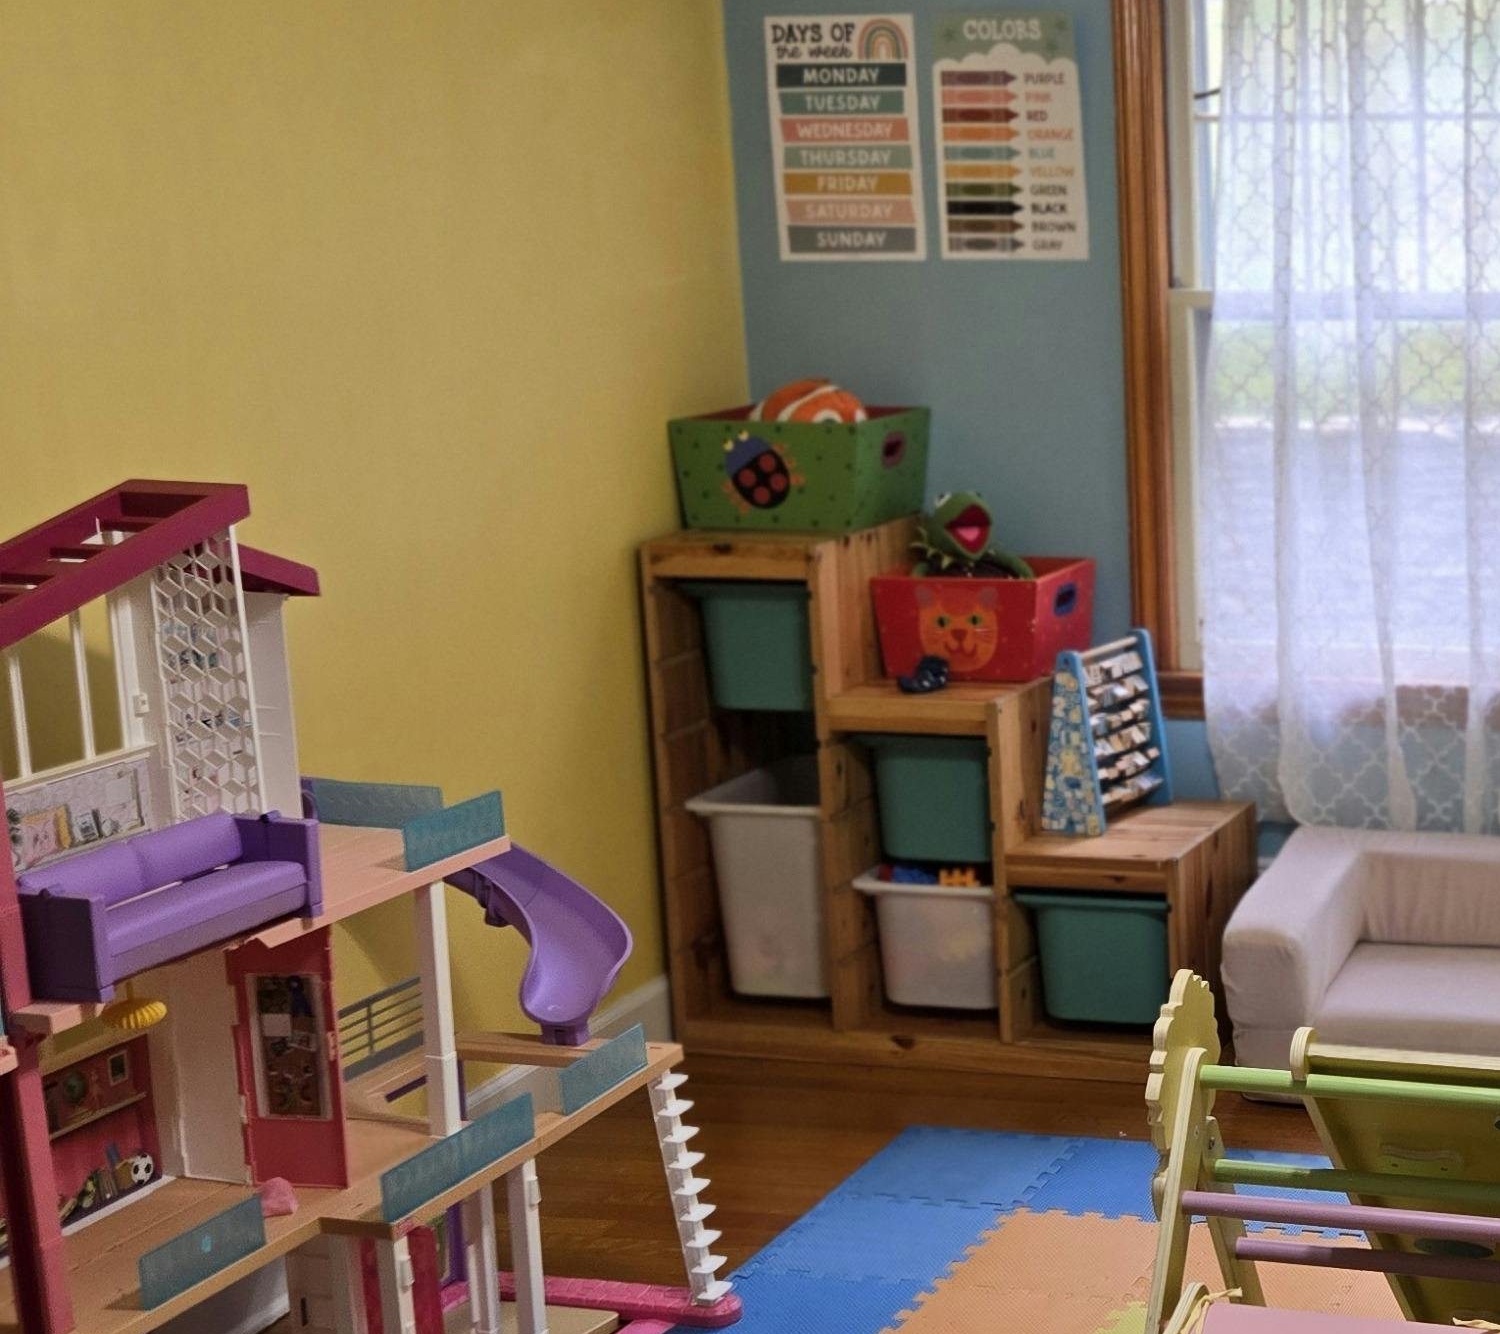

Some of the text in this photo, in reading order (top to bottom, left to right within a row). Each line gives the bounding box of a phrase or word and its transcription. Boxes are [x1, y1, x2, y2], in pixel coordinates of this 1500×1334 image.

[771, 22, 855, 44] DAYS OF
[963, 19, 1043, 41] COLORS
[775, 44, 853, 60] the week
[803, 68, 880, 84] MONDAY
[1023, 73, 1064, 85] PURPLE
[805, 94, 880, 111] TUESDAY
[1026, 110, 1049, 122] RED
[796, 122, 893, 139] WEDNESDAY
[1027, 128, 1074, 141] ORANGE
[800, 149, 892, 166] THURSDAY
[1031, 166, 1074, 178] YELLOW
[816, 176, 879, 192] FRIDAY
[1030, 184, 1068, 196] GREEN
[805, 203, 893, 220] SATURDAY
[1031, 203, 1068, 215] BLACK
[1031, 221, 1077, 233] BROWN
[817, 230, 888, 248] SUNDAY
[1032, 239, 1064, 251] GRAY
